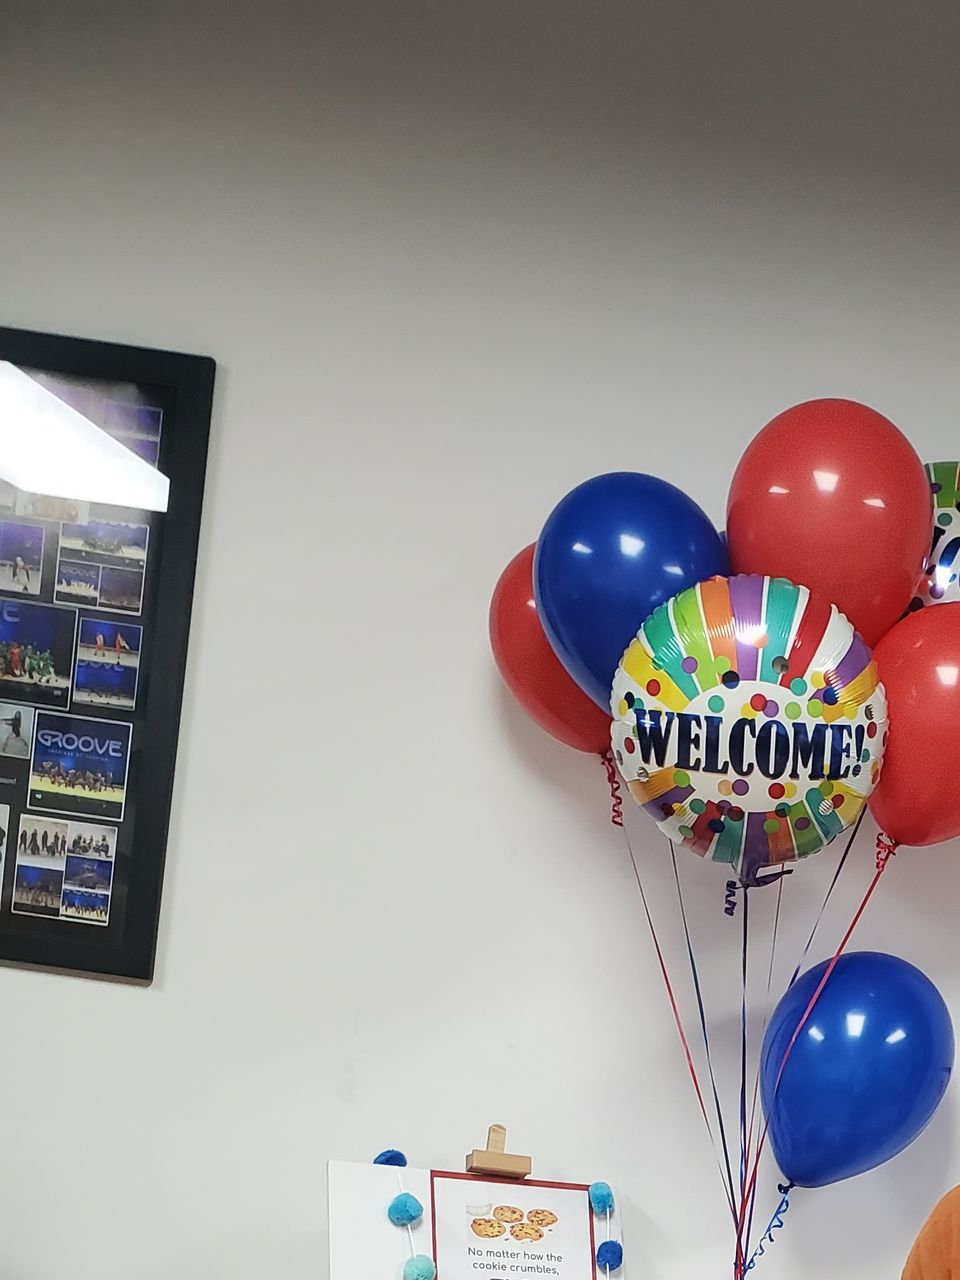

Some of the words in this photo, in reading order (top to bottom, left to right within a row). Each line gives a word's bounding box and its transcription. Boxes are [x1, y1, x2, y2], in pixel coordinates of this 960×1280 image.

[38, 729, 122, 757] GROOVE
[634, 707, 866, 781] WELCOME!
[468, 1247, 483, 1257] No
[486, 1249, 521, 1259] matter
[523, 1251, 544, 1261] how
[546, 1253, 563, 1263] the
[473, 1262, 507, 1271] cookie
[510, 1264, 560, 1276] crumbles,
